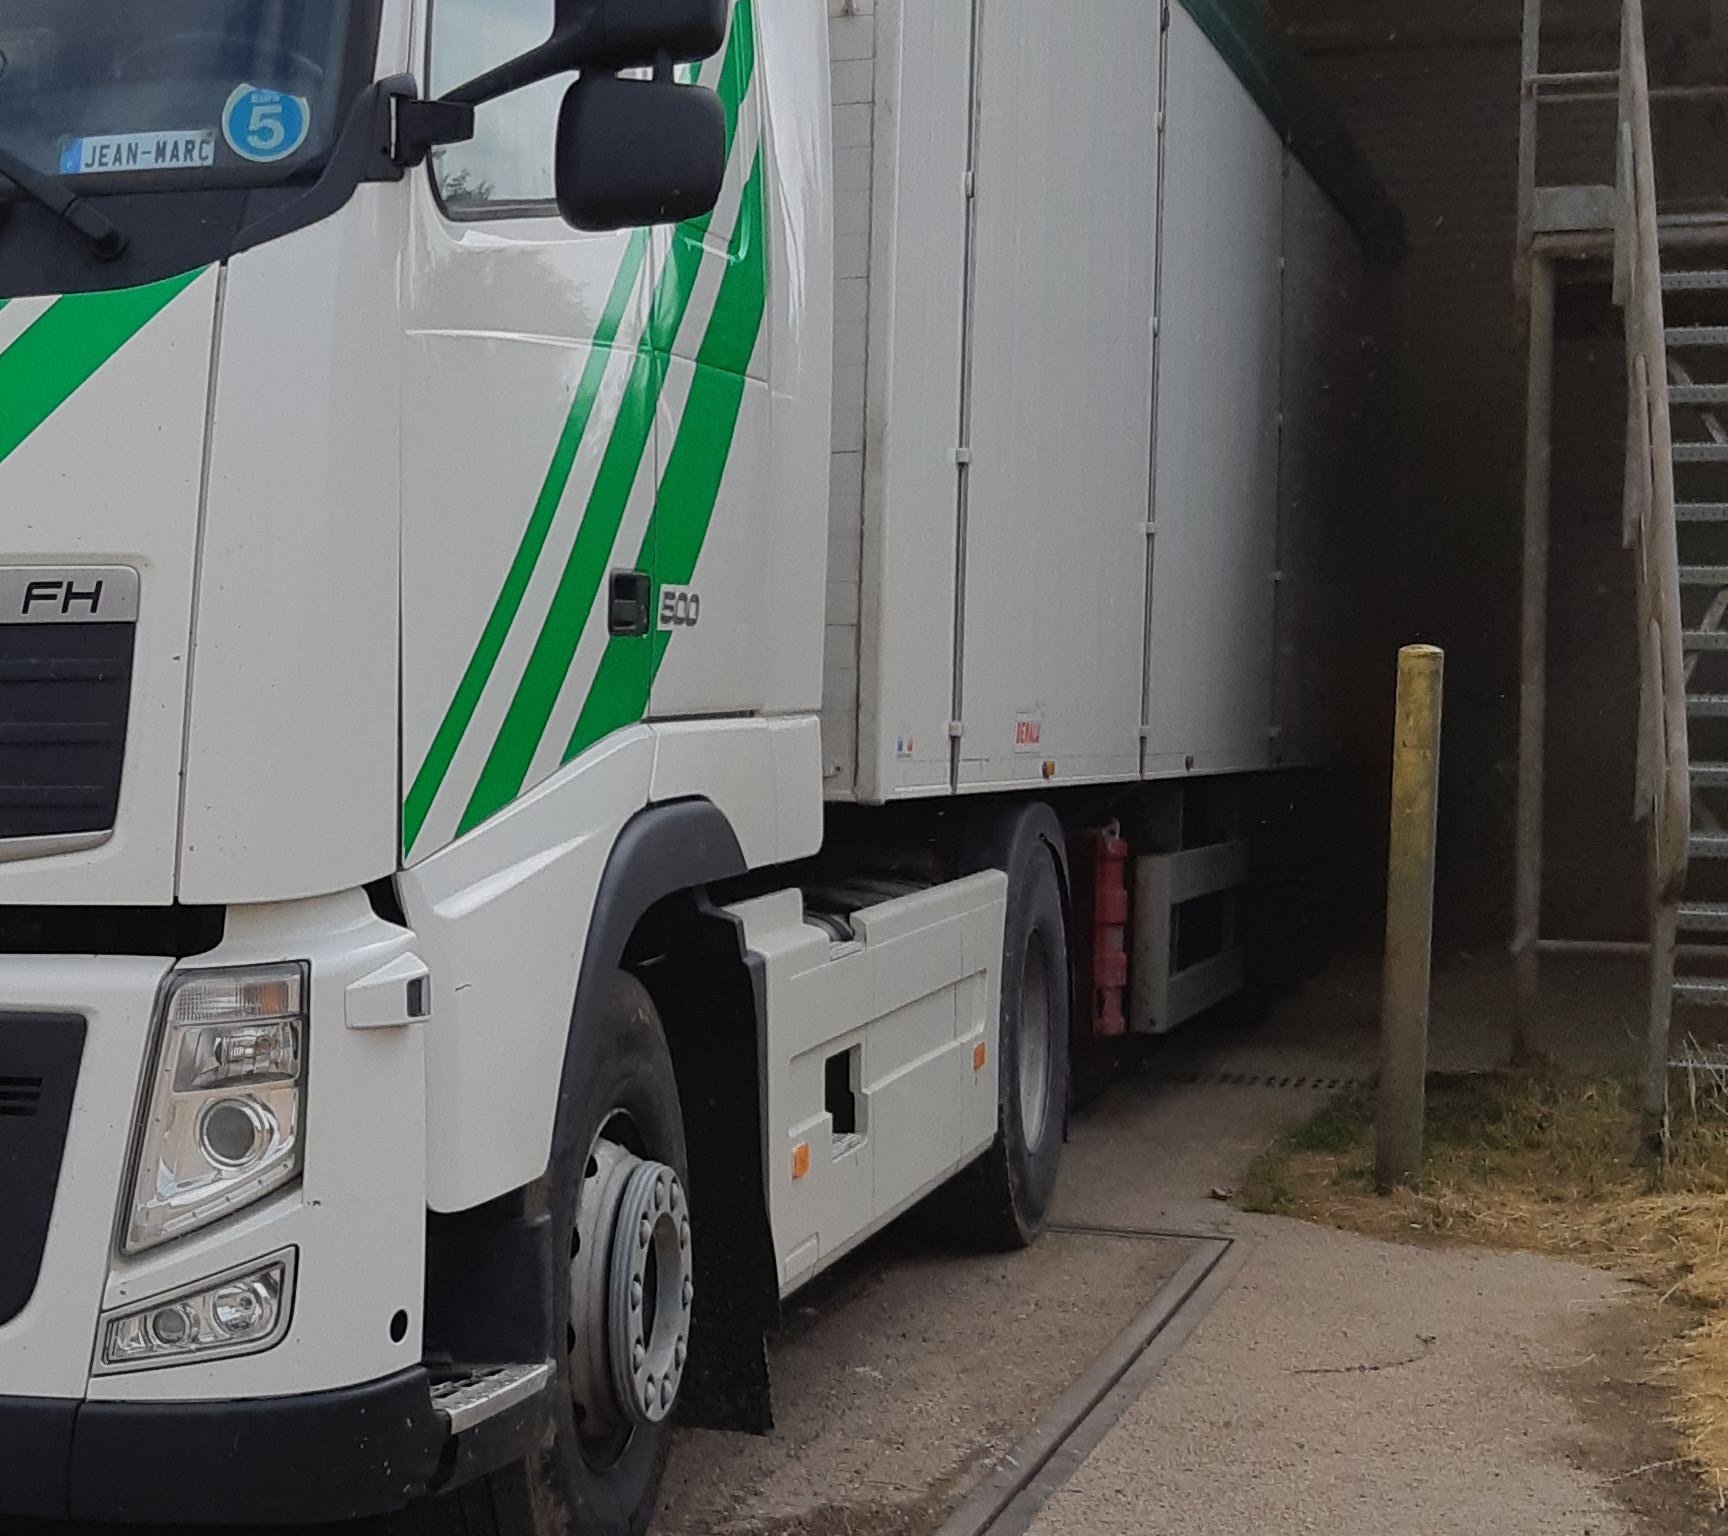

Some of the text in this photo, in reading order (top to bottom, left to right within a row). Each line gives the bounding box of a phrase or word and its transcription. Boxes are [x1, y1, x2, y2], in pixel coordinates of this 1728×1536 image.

[246, 104, 286, 150] 5
[84, 138, 210, 169] JEAN-MARC
[21, 580, 104, 614] FH
[660, 590, 700, 627] 500
